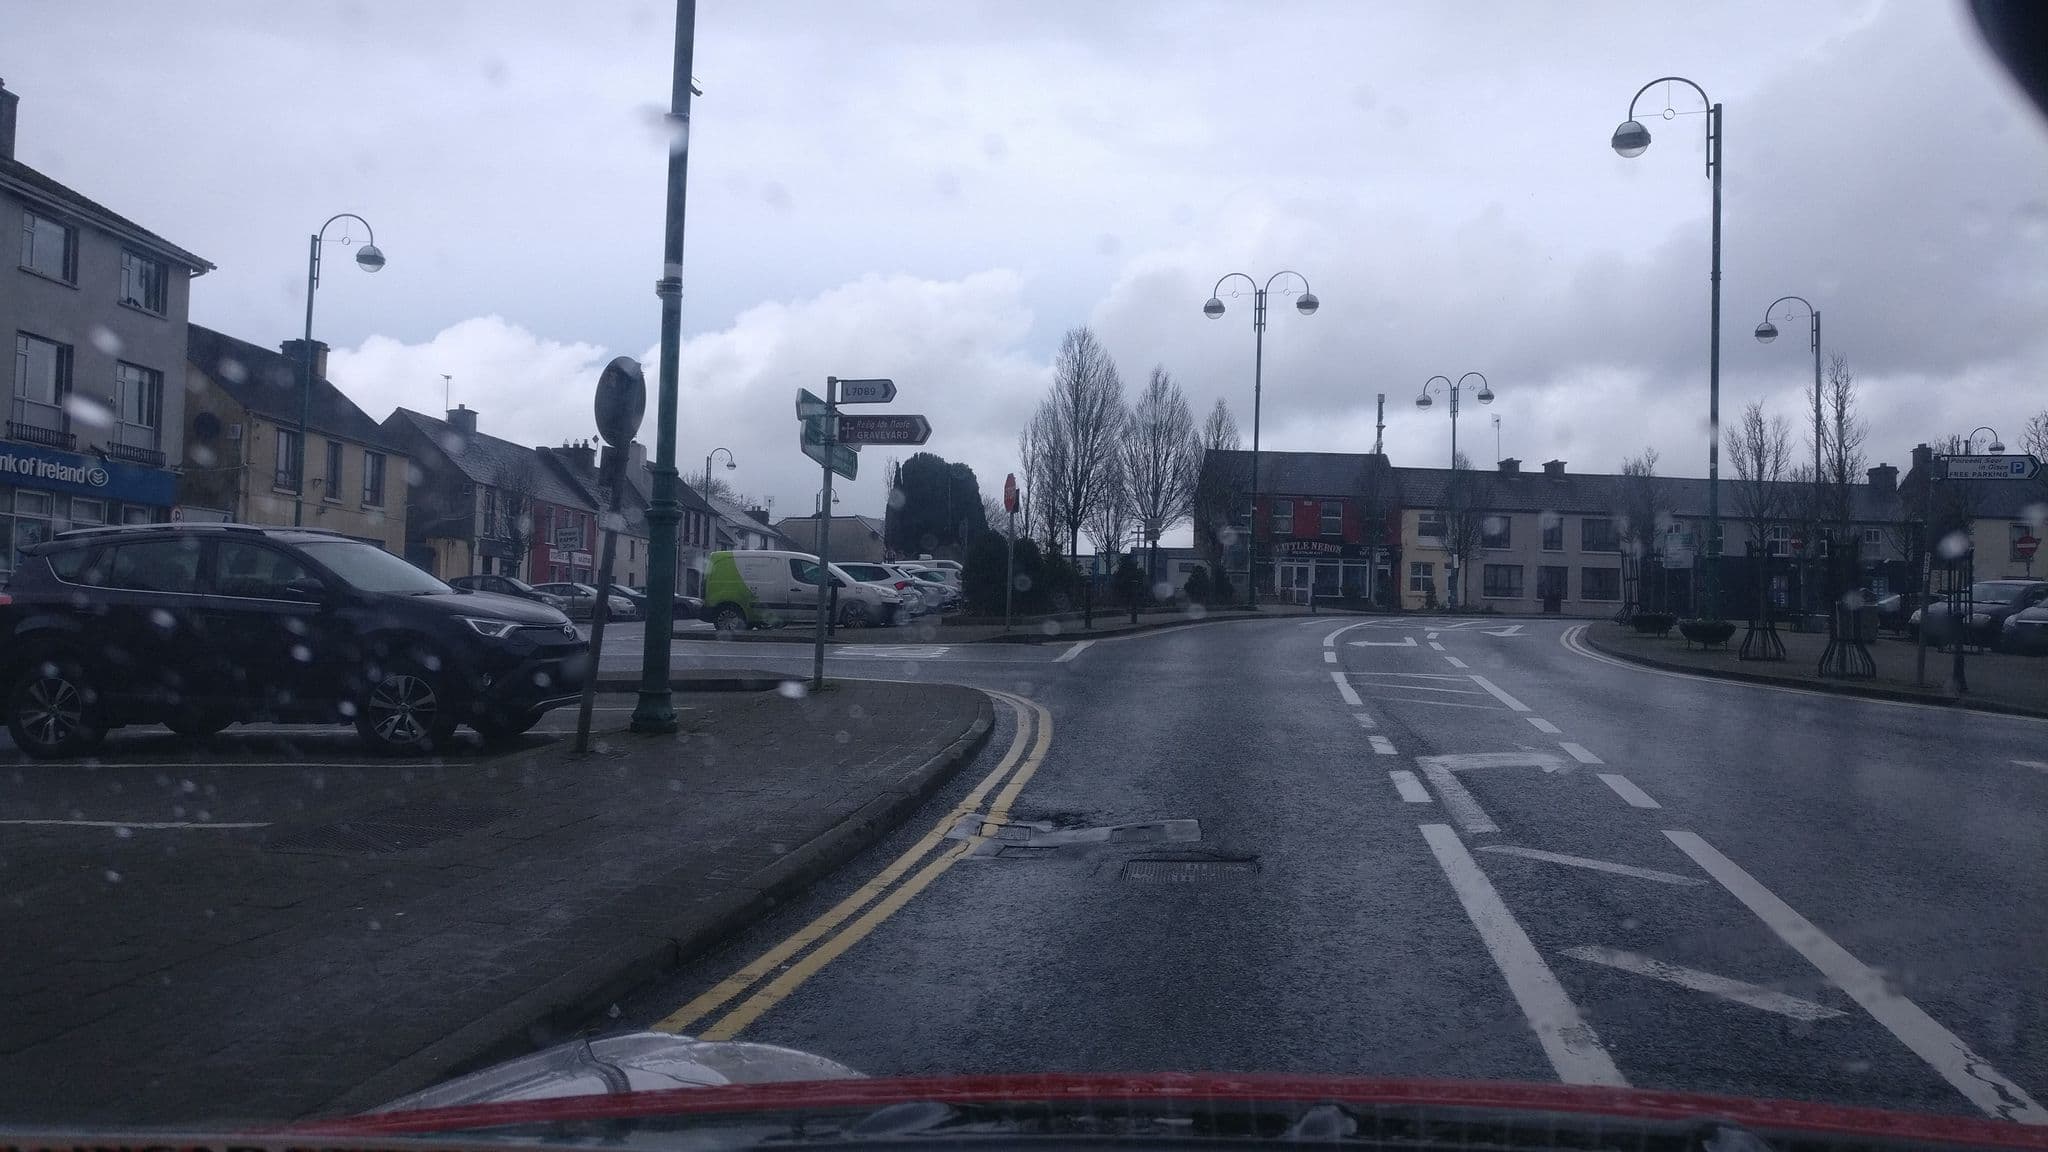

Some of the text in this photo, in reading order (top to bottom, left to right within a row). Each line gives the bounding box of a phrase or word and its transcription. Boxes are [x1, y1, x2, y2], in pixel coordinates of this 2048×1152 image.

[846, 387, 876, 397] L7089
[857, 431, 909, 440] GRAVEYARD
[19, 457, 36, 476] of
[37, 459, 85, 484] Ireland
